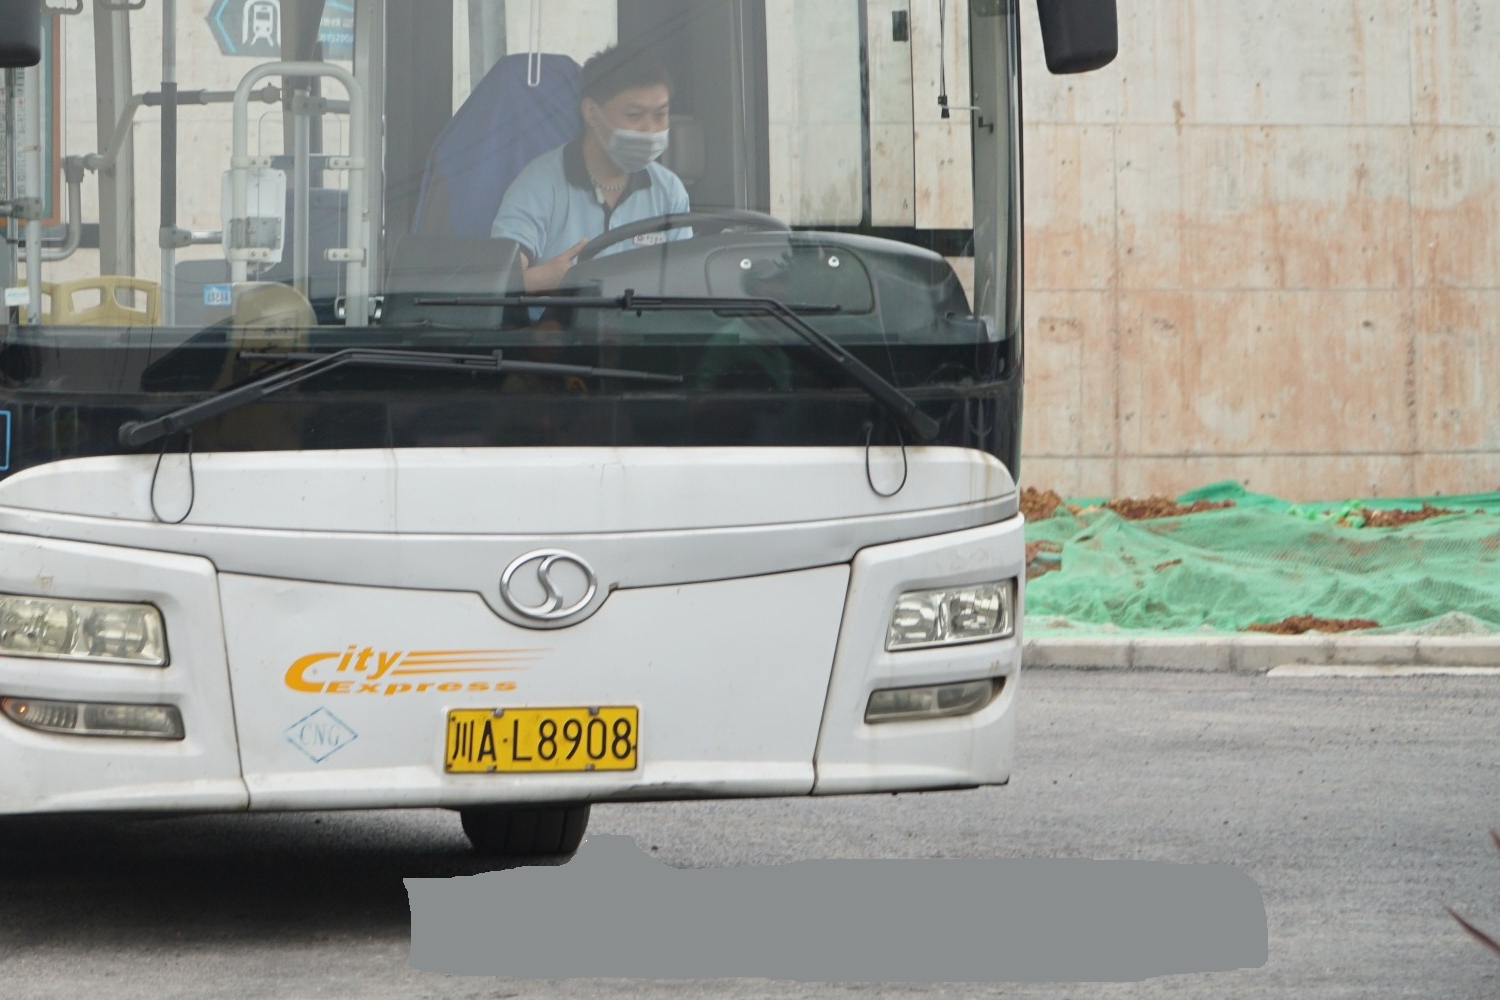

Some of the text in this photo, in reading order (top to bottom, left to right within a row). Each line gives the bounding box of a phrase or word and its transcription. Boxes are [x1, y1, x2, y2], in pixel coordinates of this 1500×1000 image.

[284, 644, 402, 693] City
[323, 680, 518, 696] Express
[299, 722, 341, 748] CNG
